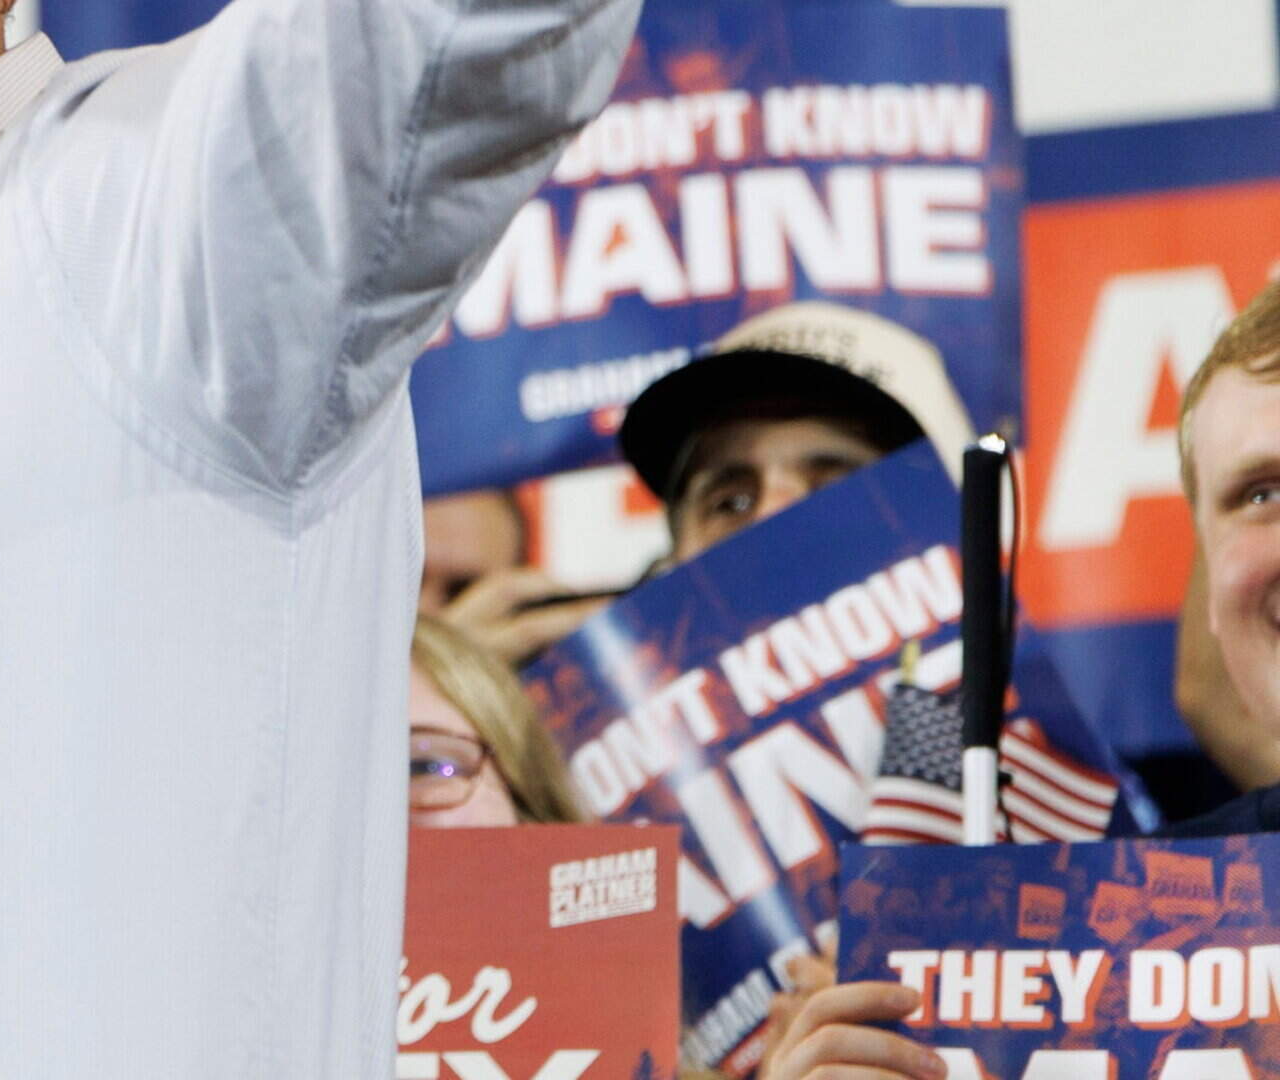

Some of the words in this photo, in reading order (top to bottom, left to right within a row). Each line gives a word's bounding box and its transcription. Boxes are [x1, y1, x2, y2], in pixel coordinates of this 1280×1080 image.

[762, 83, 986, 160] KNOW
[719, 543, 965, 717] KNOW
[550, 847, 657, 889] GRAHAM
[550, 871, 657, 914] PLATNER
[887, 949, 1108, 1023] THEY
